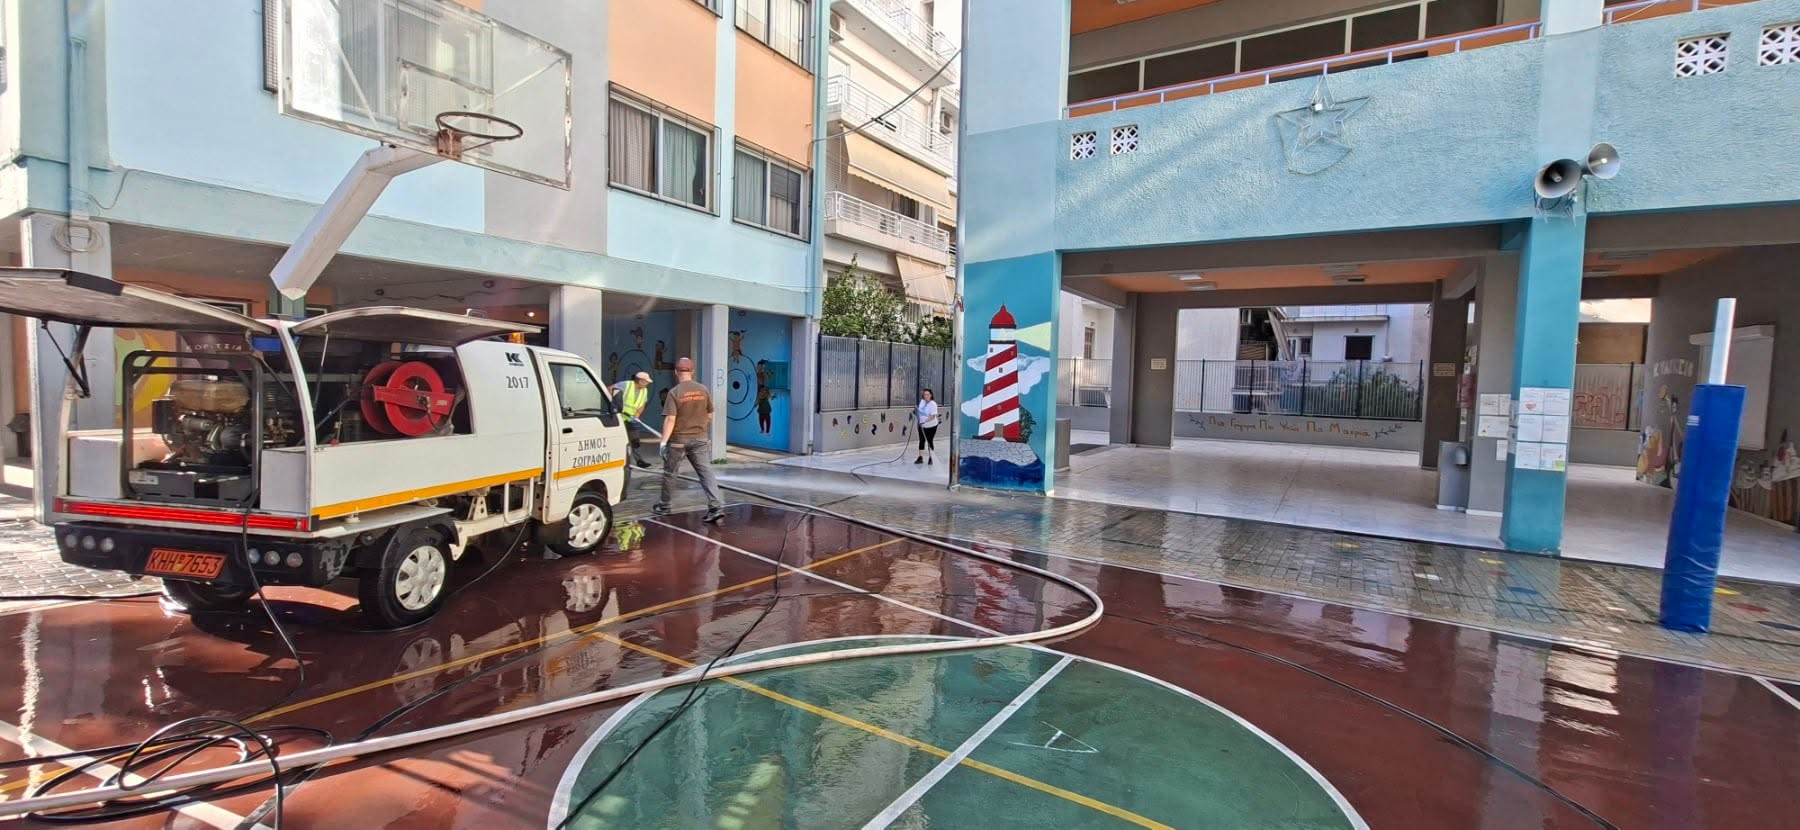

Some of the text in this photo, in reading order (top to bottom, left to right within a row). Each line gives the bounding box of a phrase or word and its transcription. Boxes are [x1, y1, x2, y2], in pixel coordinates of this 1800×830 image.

[506, 376, 529, 389] 2017
[578, 437, 607, 452] ΔΗΜΟΣ
[573, 451, 611, 469] ΖΩΓΡΑΦΟΥ
